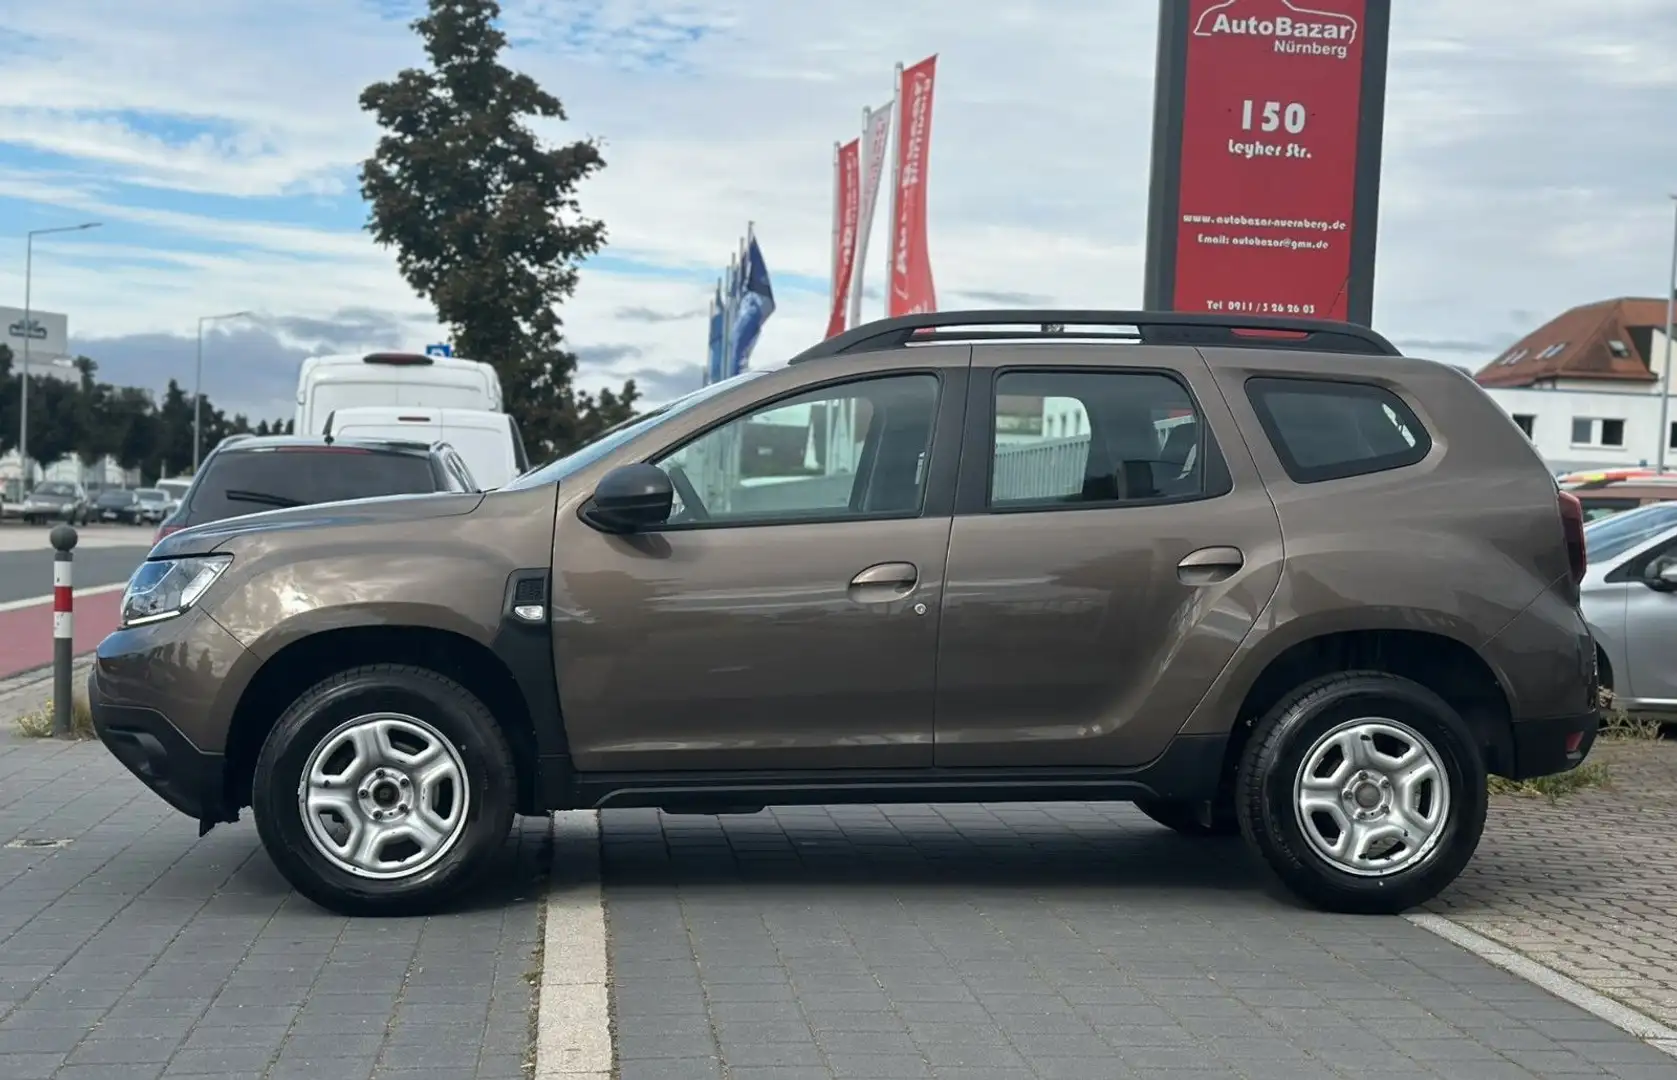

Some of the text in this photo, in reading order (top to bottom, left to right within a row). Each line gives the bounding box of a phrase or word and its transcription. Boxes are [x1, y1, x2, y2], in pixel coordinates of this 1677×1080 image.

[1212, 13, 1350, 39] AutoBazar
[1273, 40, 1347, 59] Nürnberg
[1242, 100, 1306, 134] 150
[1228, 138, 1312, 158] Leyher Str.
[1183, 214, 1346, 231] www.autobazar-nuernberg.de
[1197, 233, 1328, 250] Email: autobazar@gmx.de
[1206, 300, 1223, 310] Tel
[1228, 301, 1253, 312] 0911
[1271, 303, 1285, 313] 26
[1287, 304, 1300, 313] 26
